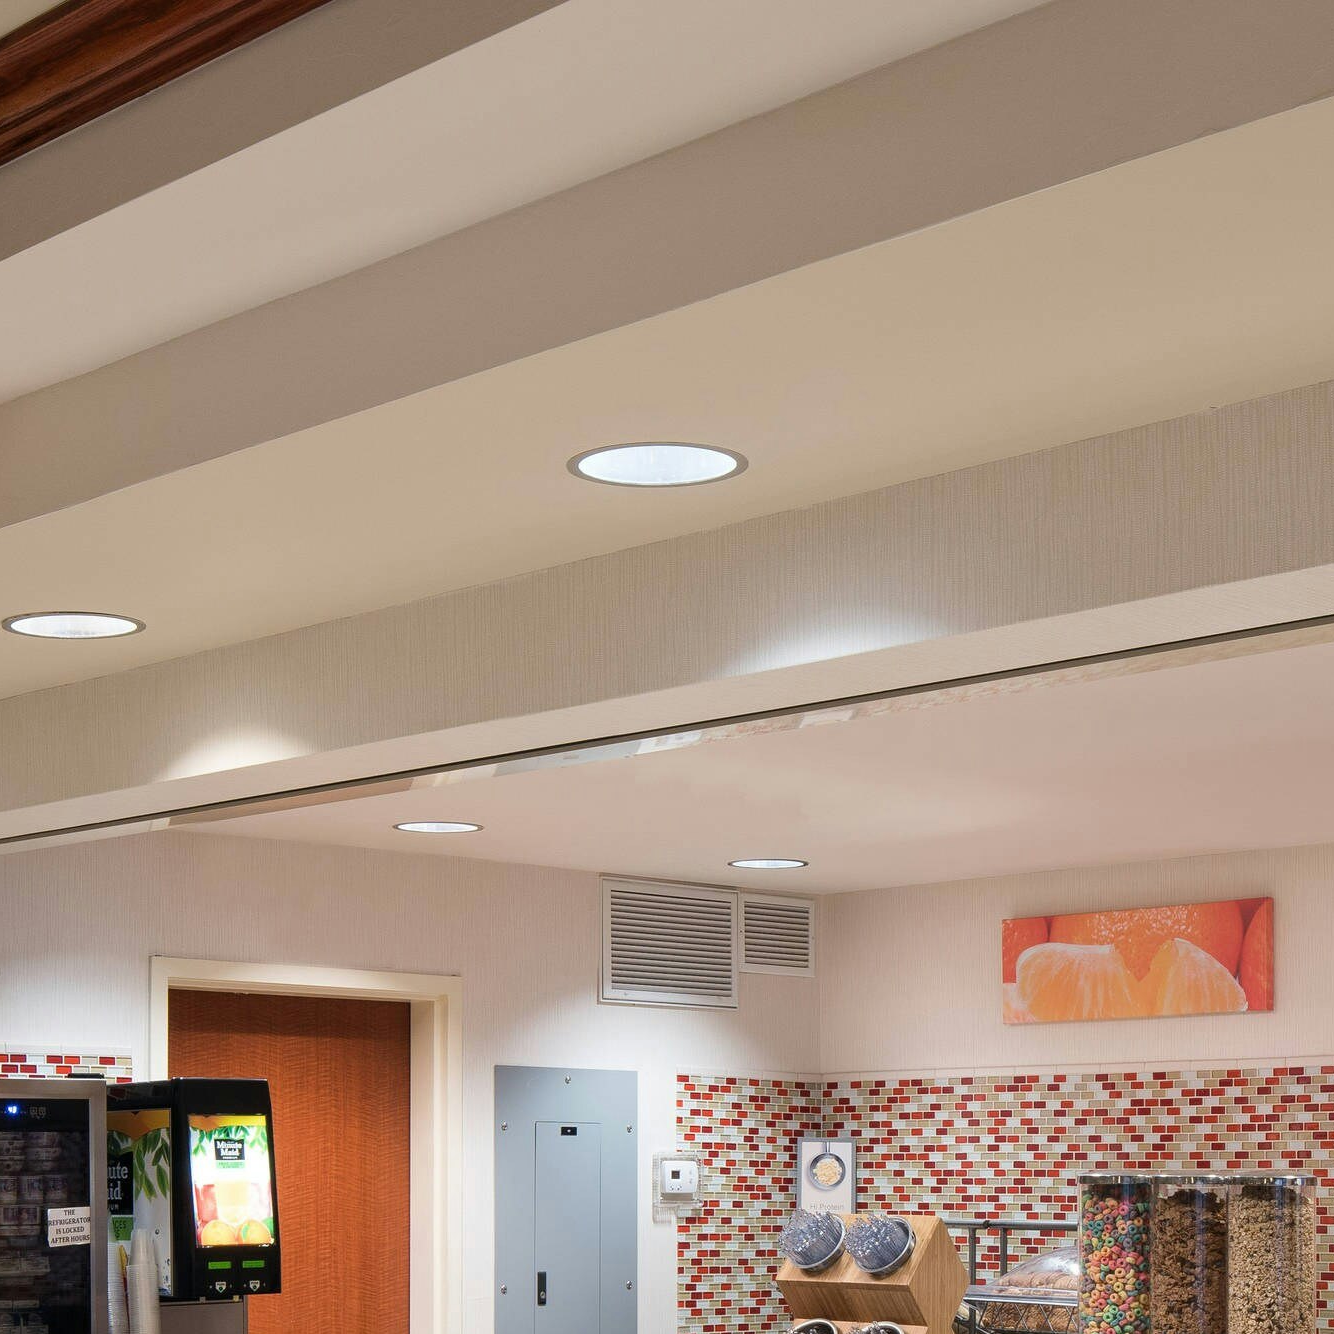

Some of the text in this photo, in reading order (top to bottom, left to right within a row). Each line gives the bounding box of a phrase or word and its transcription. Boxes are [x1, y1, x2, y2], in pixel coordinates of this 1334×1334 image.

[221, 1148, 240, 1156] Maid
[107, 1162, 128, 1179] ute
[107, 1181, 123, 1200] id
[49, 1216, 91, 1226] REFRIGERATOR
[63, 1226, 84, 1234] LOCKED
[71, 1234, 90, 1242] HOURS
